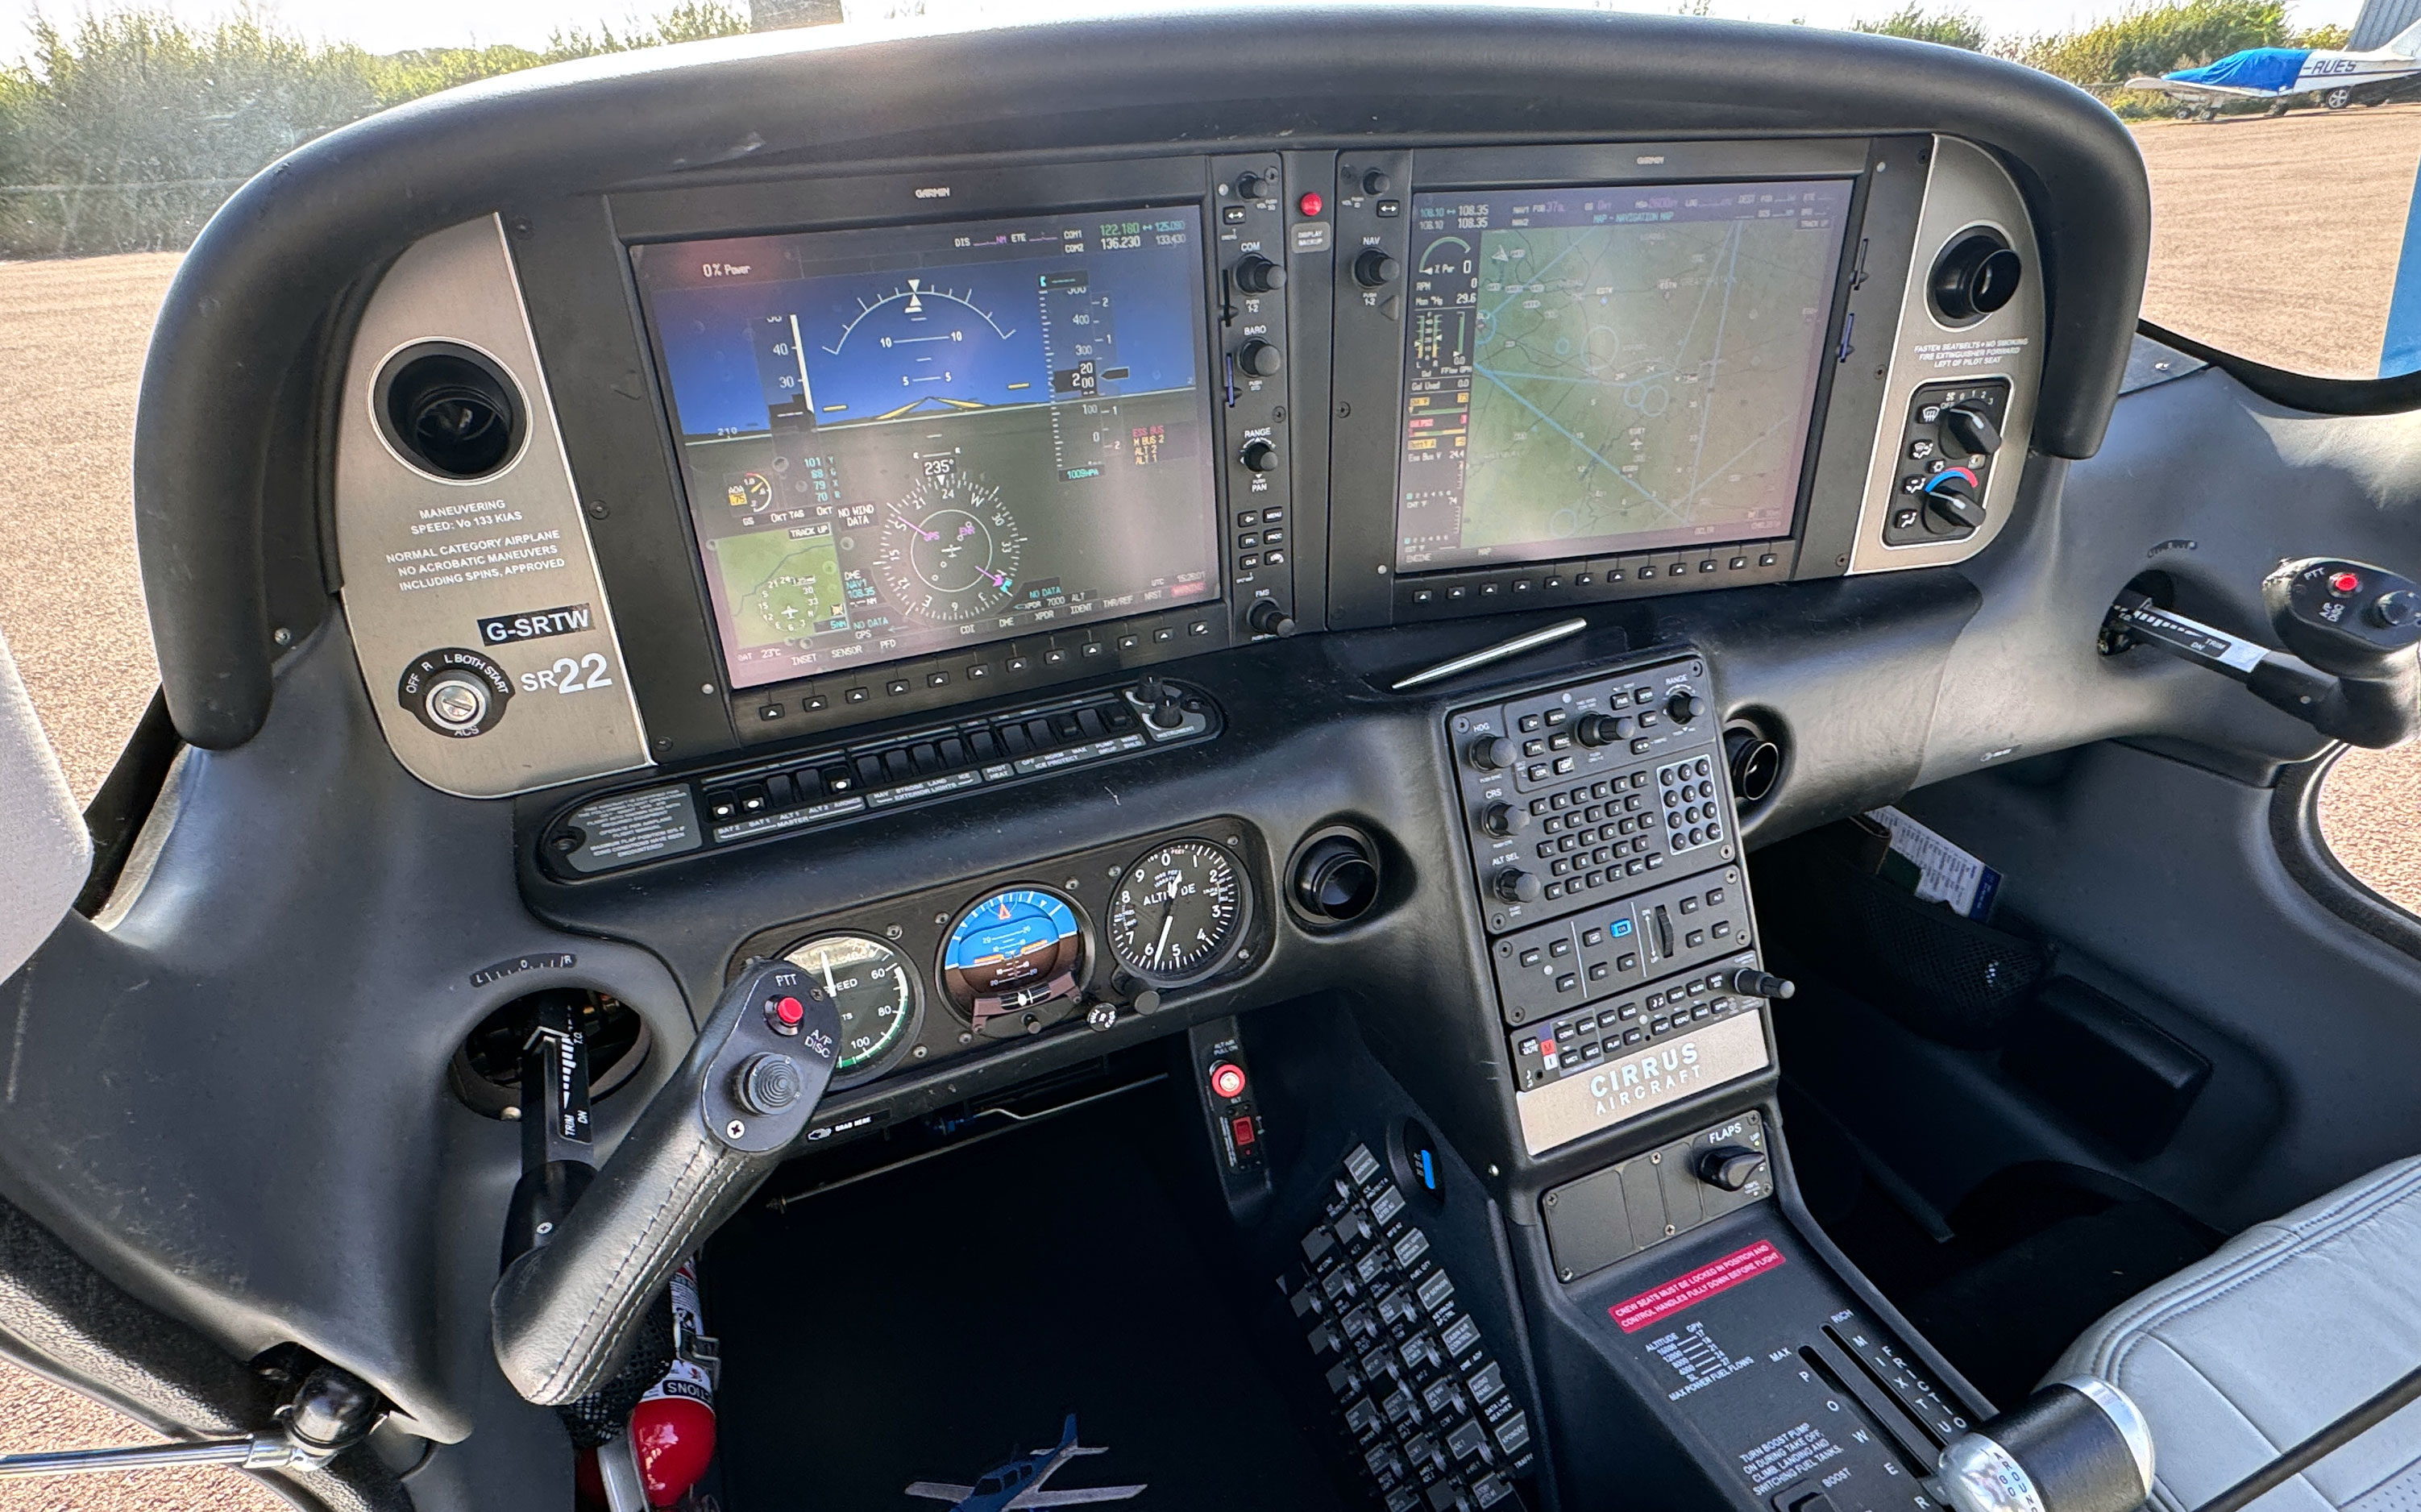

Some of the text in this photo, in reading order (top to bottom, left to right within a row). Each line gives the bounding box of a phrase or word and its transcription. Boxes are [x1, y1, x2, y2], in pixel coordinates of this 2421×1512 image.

[915, 187, 950, 198] GARMIN
[1459, 205, 1489, 216] 108.35
[1457, 218, 1488, 228] 108.35
[1011, 233, 1026, 243] ETE
[1064, 231, 1082, 240] COM1
[1298, 231, 1323, 239] DISPLAY
[1363, 237, 1381, 245] NAV
[954, 237, 970, 247] DIS
[1100, 236, 1141, 250] 136.230
[1241, 242, 1260, 251] COM
[1298, 238, 1323, 246] BACKUP
[1065, 243, 1084, 254] COM2
[703, 264, 752, 277] 0% Power
[1456, 293, 1476, 305] 29.6
[1073, 314, 1090, 326] 400
[1244, 325, 1266, 335] BARO
[880, 337, 892, 348] 10
[951, 331, 962, 342] 10
[772, 343, 788, 356] 40
[1075, 345, 1093, 356] 300
[1914, 344, 1941, 353] FASTEN
[1941, 342, 1980, 351] SEATBELTS
[1936, 350, 1985, 359] EXTINGUISHER
[1987, 347, 2020, 355] FORWARD
[1963, 358, 1983, 366] PILOT
[779, 376, 795, 388] 30
[1083, 405, 1098, 414] 100
[1244, 426, 1272, 438] RANGE
[1252, 484, 1268, 492] PAN
[419, 499, 505, 520] MANEUVERING
[838, 505, 874, 518] NO WIND
[1266, 511, 1281, 519] MENU
[410, 511, 523, 535] SPEED: Vo 133 KIAS
[847, 516, 870, 526] DATA
[791, 525, 829, 538] TRACK UP
[386, 530, 560, 563] NORMAL CATEGORY AIRPLANE
[398, 545, 559, 577] NO ACROBATIC MANEUVERS
[399, 558, 565, 592] INCLUDING SPINS, APPROVED
[845, 570, 862, 579] DME
[2303, 567, 2325, 580] PTT
[846, 579, 867, 589] NAV1
[1256, 588, 1269, 597] FMS
[1070, 603, 1093, 614] IDENT
[1035, 610, 1054, 621] XPDR
[486, 609, 590, 642] G-SRTW
[853, 617, 889, 630] NO DATA
[999, 617, 1015, 627] DME
[855, 630, 872, 639] GPS
[960, 624, 975, 635] CDI
[880, 639, 896, 650] PFD
[2204, 638, 2227, 650] TRIM
[832, 646, 862, 658] SENSOR
[444, 654, 486, 669] L BOTH
[791, 654, 817, 665] INSET
[521, 652, 613, 695] SR22
[405, 673, 420, 695] OFF
[484, 666, 509, 696] START
[1665, 675, 1688, 685] RANGE
[1156, 726, 1194, 739] INSTRUMENT
[1473, 722, 1490, 732] HDG
[1095, 741, 1115, 749] PUMP
[986, 765, 1006, 773] PITOT
[990, 771, 1008, 779] HEAT
[895, 784, 924, 794] STROBE
[927, 779, 947, 787] LAND
[895, 783, 957, 800] EXTERIOR LIGHTS
[1485, 788, 1501, 799] CRS
[777, 816, 809, 828] MASTER
[780, 812, 794, 820] ALT
[1161, 853, 1171, 866] 0
[1492, 852, 1519, 866] ALT SEL
[1135, 869, 1145, 883] 9
[1210, 870, 1218, 883] 2
[1122, 890, 1130, 903] 8
[1144, 883, 1196, 906] ALTIDE
[1212, 905, 1221, 918] 3
[1126, 931, 1134, 945] 7
[1144, 943, 1154, 956] 6
[1173, 944, 1181, 957] 5
[871, 968, 885, 979] 60
[775, 974, 799, 987] PTT
[878, 1006, 891, 1016] 80
[811, 1029, 833, 1045] A/P
[851, 1036, 870, 1049] 100
[804, 1036, 832, 1058] DISC
[1590, 1042, 1698, 1097] CIRRUS
[1596, 1065, 1701, 1115] AIRCRAFT
[578, 1111, 588, 1124] DN
[565, 1115, 575, 1136] TRIM
[1709, 1122, 1742, 1144] FLAPS
[1615, 1245, 1770, 1317] CREW SEATS MUST BE LOCKED IN POSITION AND
[1622, 1252, 1779, 1327] CONTROL HANDLES FULLY DOWN BEFORE FLIGHT
[1830, 1309, 1854, 1323] RICH
[1686, 1322, 1704, 1333] GPH
[1645, 1333, 1680, 1352] ALTITUDE
[1769, 1347, 1792, 1363] MAX
[1668, 1356, 1754, 1402] MAX POWER FUEL FLOWS
[1739, 1422, 1810, 1463] TURN BOOST PUMP
[1743, 1464, 1756, 1475] ON
[1758, 1448, 1788, 1468] DURING
[1785, 1439, 1807, 1456] TAKE
[1779, 1449, 1813, 1468] LANDING
[1812, 1439, 1830, 1452] AND
[1753, 1471, 1798, 1496] SWITCHING
[1796, 1460, 1818, 1474] FUEL
[1821, 1468, 1852, 1488] BOOST
